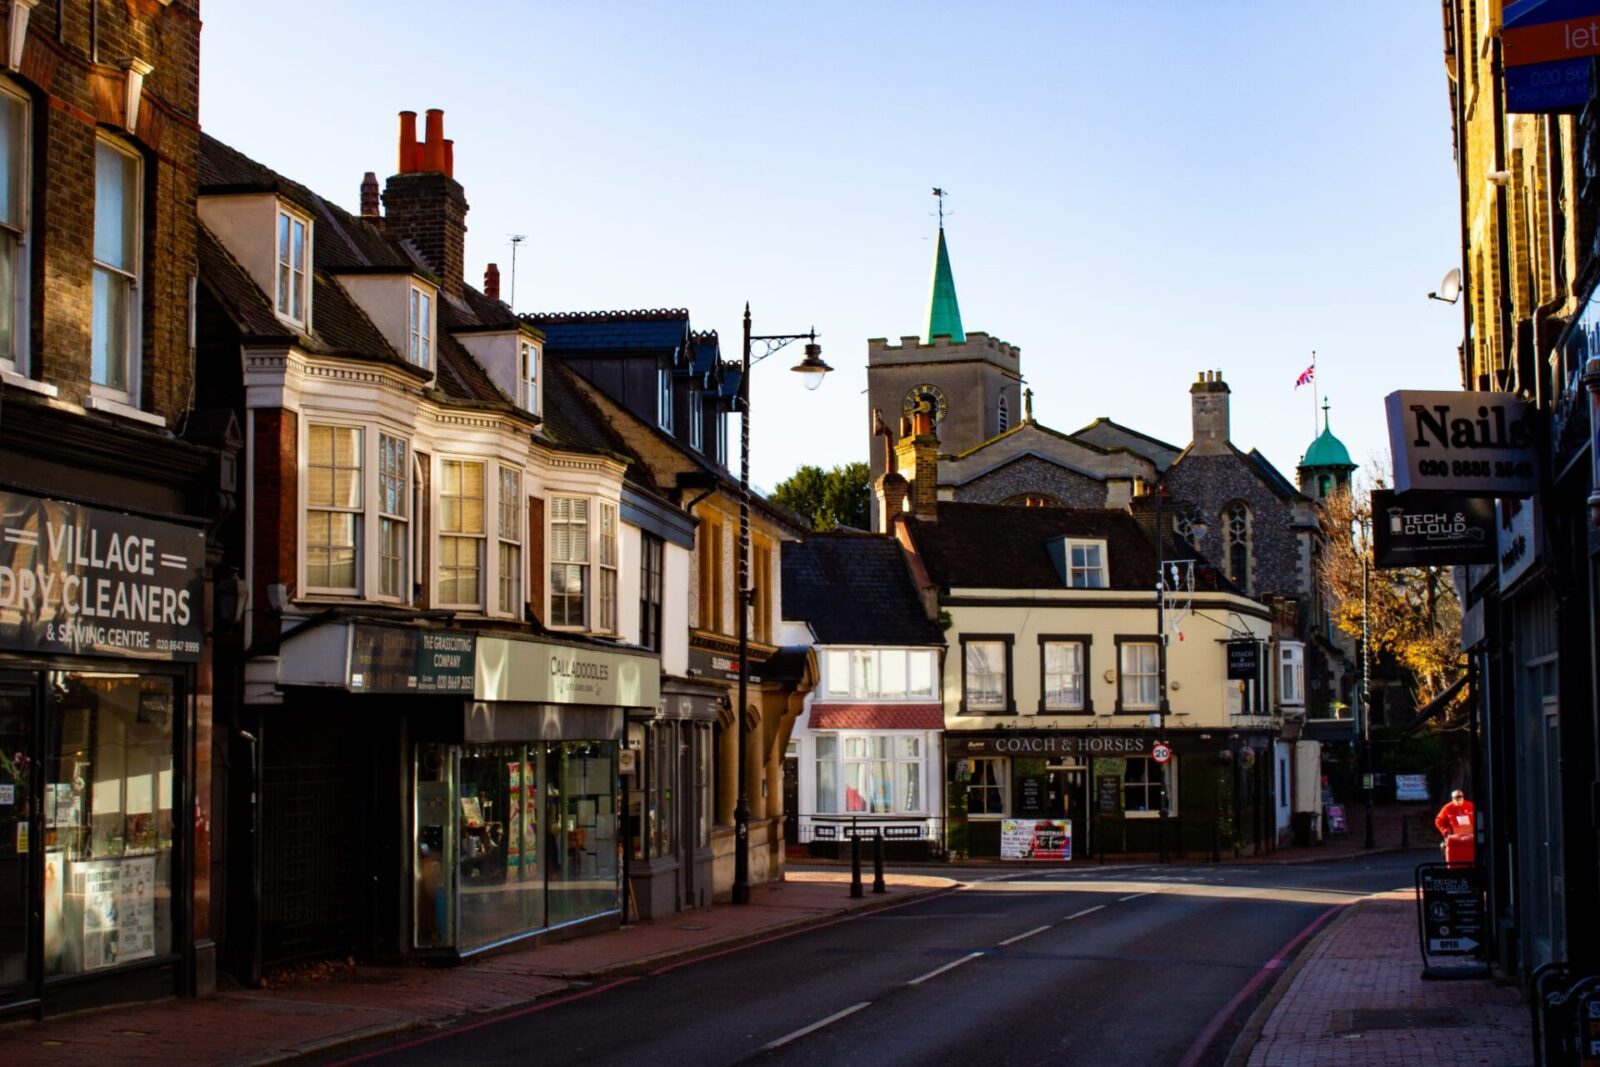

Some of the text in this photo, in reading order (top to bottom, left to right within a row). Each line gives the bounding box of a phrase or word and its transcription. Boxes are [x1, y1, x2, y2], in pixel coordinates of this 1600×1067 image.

[1564, 22, 1599, 50] let
[1410, 405, 1535, 450] Nails
[1419, 460, 1448, 476] 020
[1403, 512, 1466, 524] TECH &
[1405, 523, 1467, 535] CLOUD
[46, 521, 156, 576] VILLAGE
[0, 566, 191, 626] DRY CLEANERS
[46, 624, 150, 649] & SEWING CENTRE
[424, 635, 434, 650] THE
[156, 639, 169, 650] 020
[434, 654, 461, 668] COMPANY
[437, 675, 447, 689] 020
[995, 738, 1056, 752] COACH
[1061, 738, 1073, 752] &
[1078, 738, 1144, 752] HORSES
[1155, 749, 1169, 758] 20
